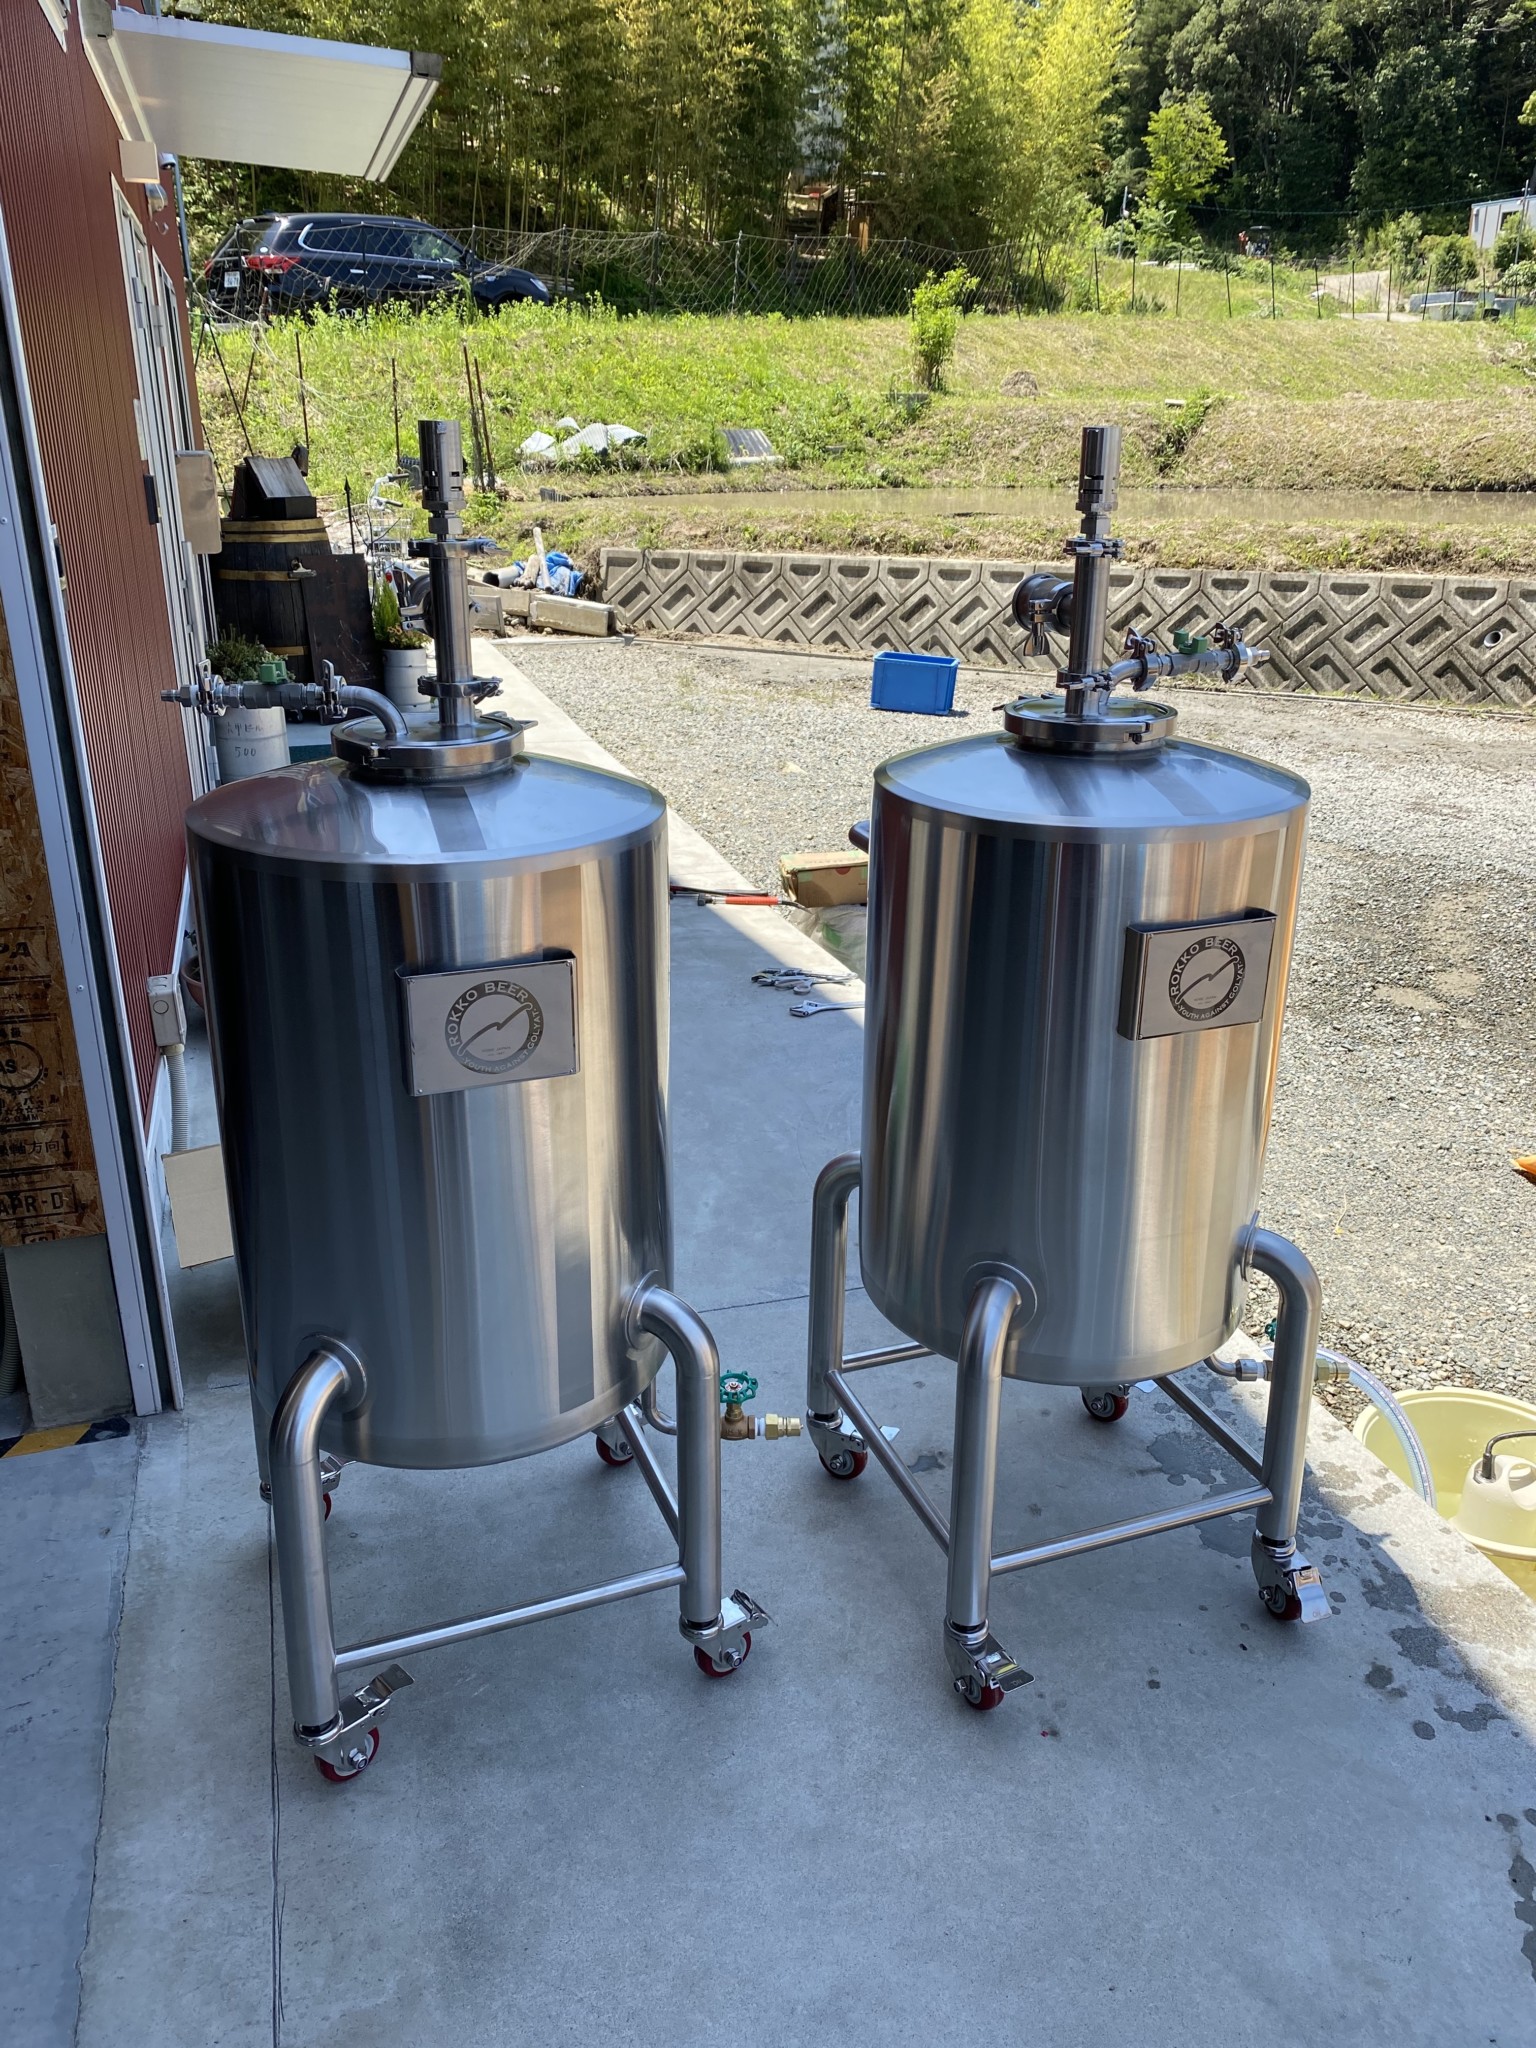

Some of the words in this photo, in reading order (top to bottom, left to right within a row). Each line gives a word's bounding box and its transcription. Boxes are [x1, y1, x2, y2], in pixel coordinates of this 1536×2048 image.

[234, 746, 257, 758] 500
[1171, 944, 1199, 996] ROKKO
[1205, 938, 1238, 956] BEER
[447, 989, 478, 1047] ROKKO
[484, 981, 529, 1002] BEER
[1201, 1000, 1230, 1019] AGAINST
[494, 1050, 529, 1072] AGAINST
